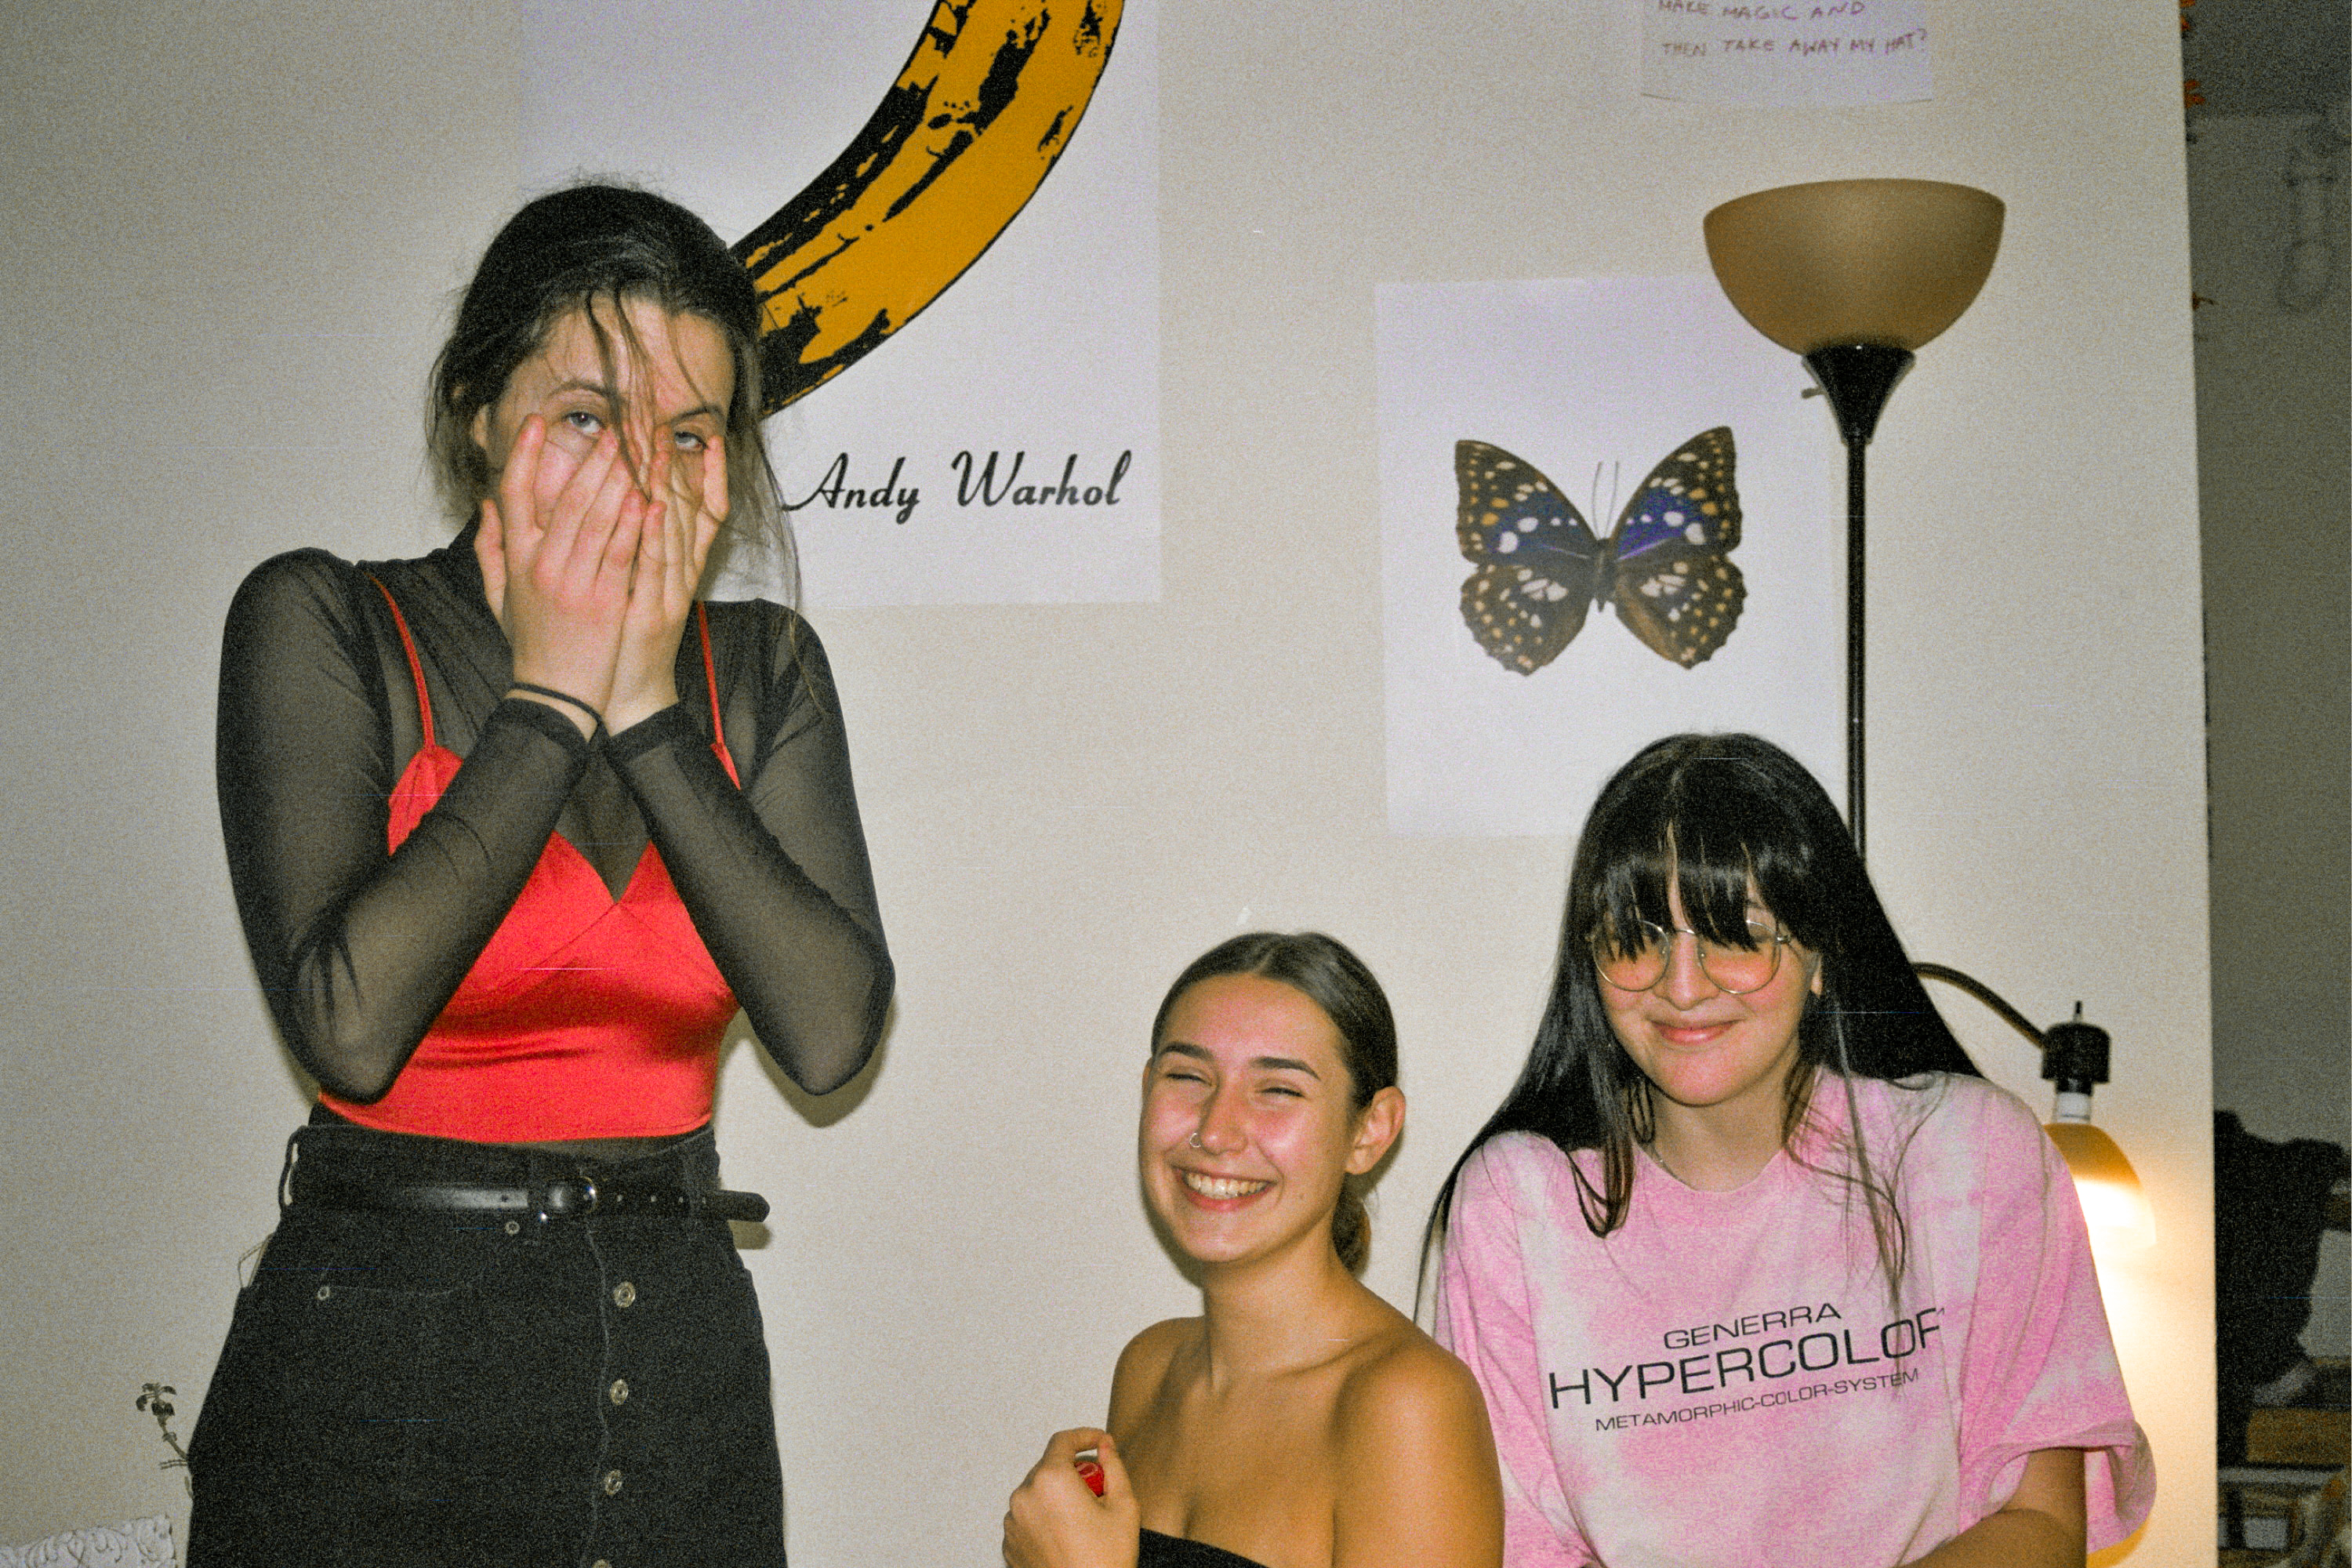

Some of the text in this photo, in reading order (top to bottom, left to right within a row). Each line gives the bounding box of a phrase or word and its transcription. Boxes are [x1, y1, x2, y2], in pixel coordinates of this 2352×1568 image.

[1722, 5, 1798, 20] MAGIC
[1809, 2, 1865, 20] AND
[1662, 42, 1707, 57] THEN
[1725, 38, 1775, 53] TAKE
[1788, 38, 1840, 56] AWAY
[1849, 38, 1875, 53] MY
[782, 449, 1133, 525] Andy Warhol
[1664, 1302, 1842, 1350] GENERRA
[1595, 1367, 1919, 1432] METAMORPHIC-COLOR-SYSTEM
